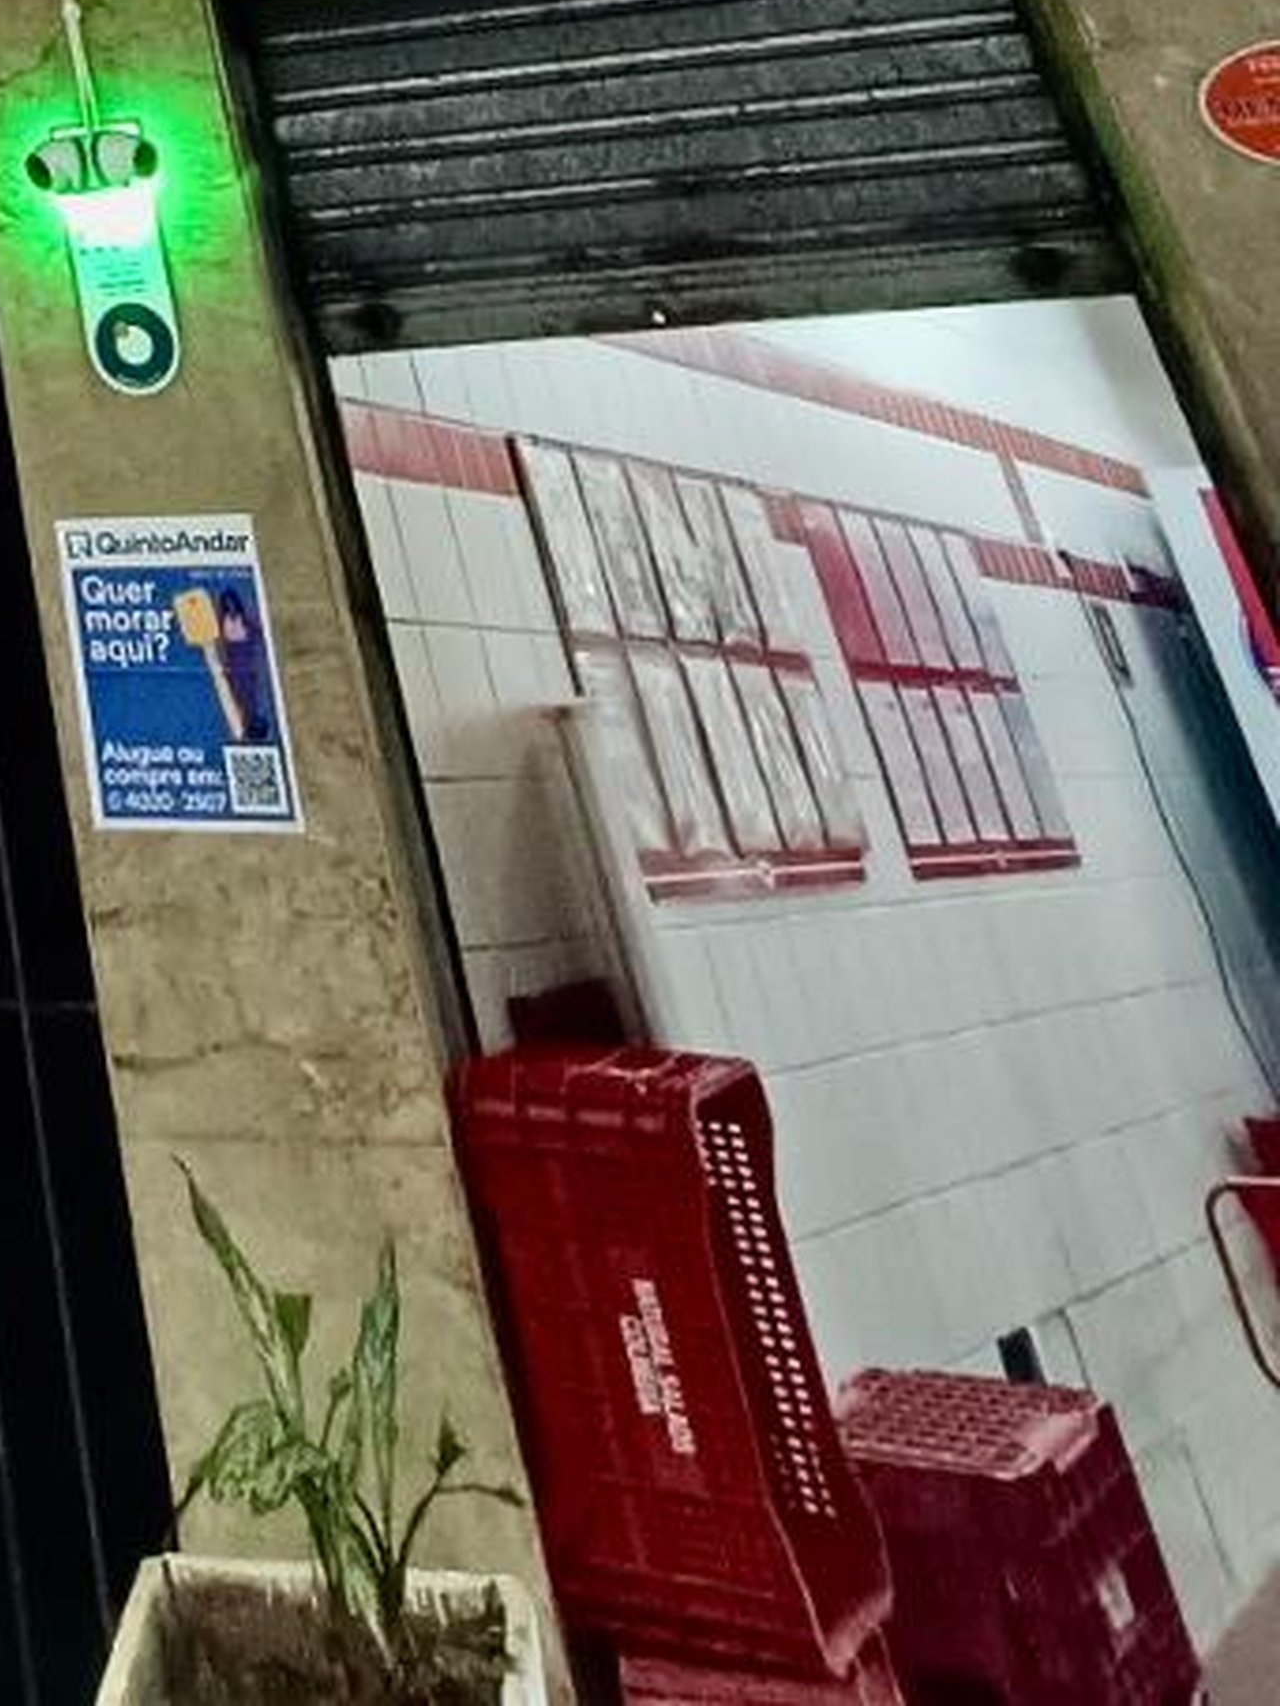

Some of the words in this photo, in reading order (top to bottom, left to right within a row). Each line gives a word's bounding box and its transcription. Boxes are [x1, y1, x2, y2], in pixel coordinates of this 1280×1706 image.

[96, 529, 250, 555] QuintoAndar
[81, 574, 156, 606] Quer
[85, 608, 174, 633] morar
[90, 632, 171, 668] aqui?
[102, 738, 174, 767] Alugue
[177, 745, 205, 763] ou
[104, 767, 182, 794] compre
